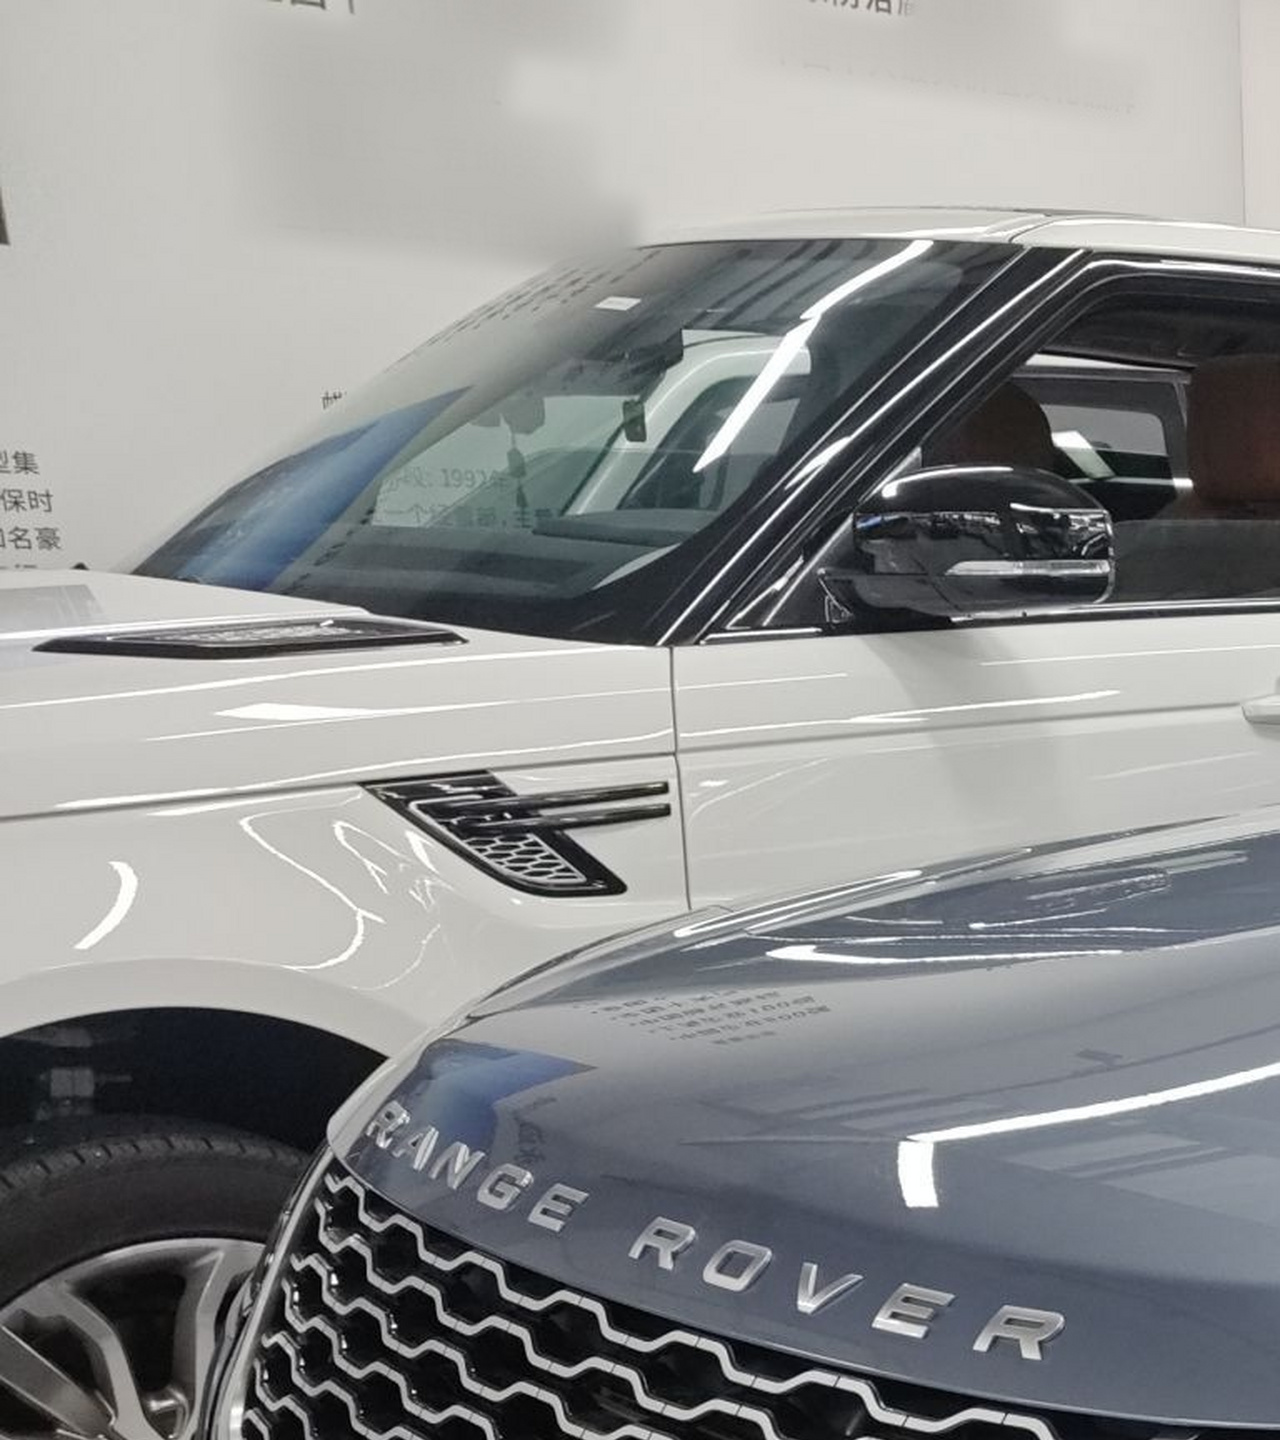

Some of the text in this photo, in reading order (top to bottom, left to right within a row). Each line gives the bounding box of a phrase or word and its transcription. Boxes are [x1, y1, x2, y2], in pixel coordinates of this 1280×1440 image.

[0, 525, 61, 551] 名豪
[366, 1100, 1066, 1361] RANGE ROVER
